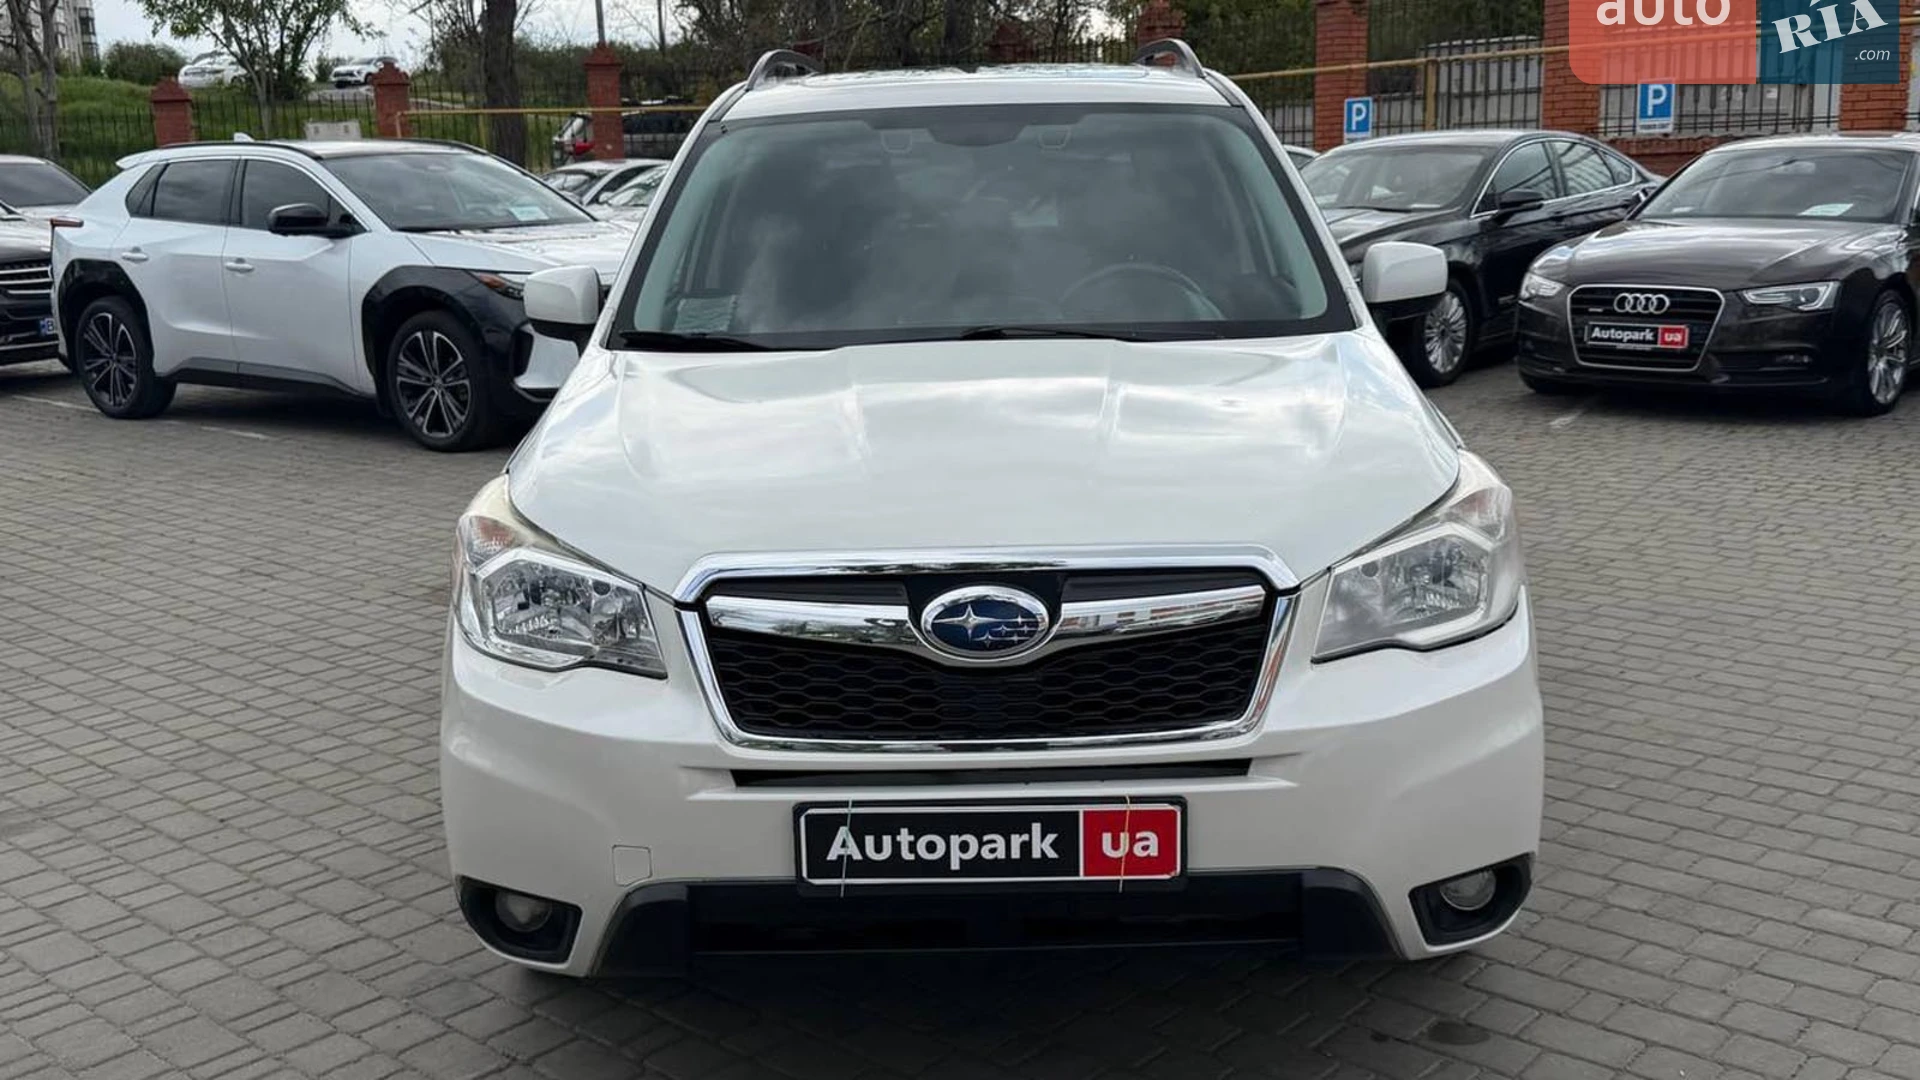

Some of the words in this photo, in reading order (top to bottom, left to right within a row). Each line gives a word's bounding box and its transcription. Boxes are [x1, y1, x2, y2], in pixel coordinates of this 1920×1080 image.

[1647, 84, 1667, 116] P
[1352, 103, 1367, 131] P
[1591, 327, 1654, 342] Autopark
[1664, 332, 1682, 342] ua
[826, 822, 1059, 870] Autopark
[1101, 830, 1160, 858] ua
